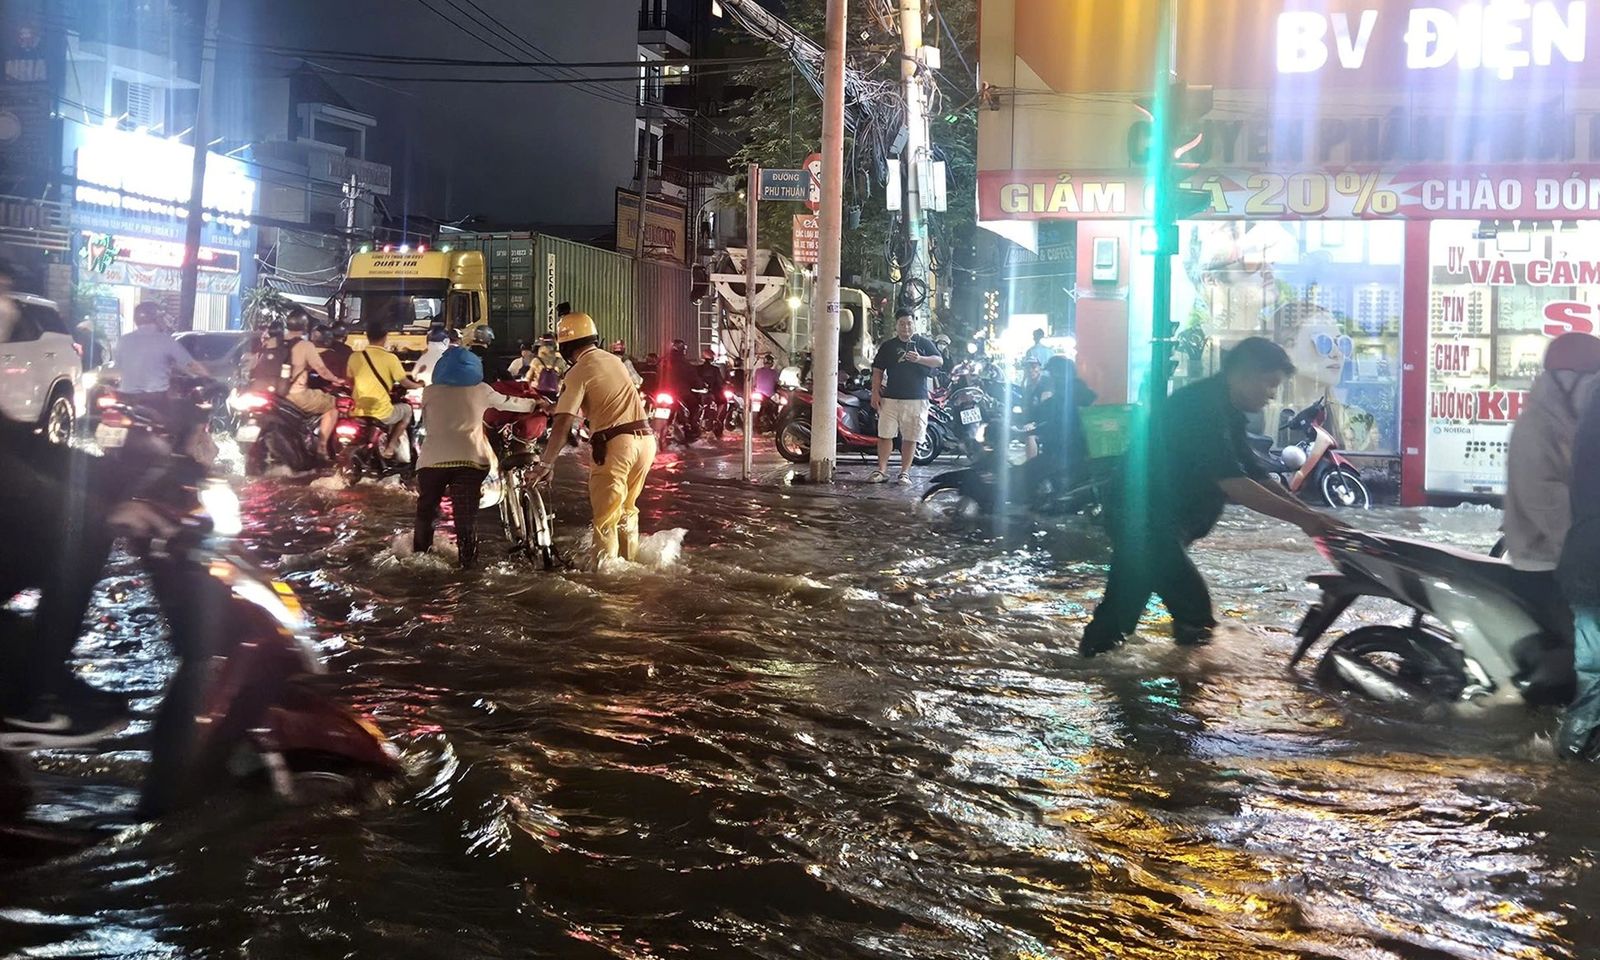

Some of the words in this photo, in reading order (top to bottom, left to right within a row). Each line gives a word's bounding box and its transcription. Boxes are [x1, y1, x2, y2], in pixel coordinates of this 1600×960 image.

[1276, 10, 1378, 73] BV
[1404, 0, 1586, 80] ĐIỆN
[1000, 174, 1126, 213] GIẢM
[1245, 168, 1399, 216] 20%
[1422, 172, 1522, 211] CHÀO
[1468, 252, 1514, 284] VÀ
